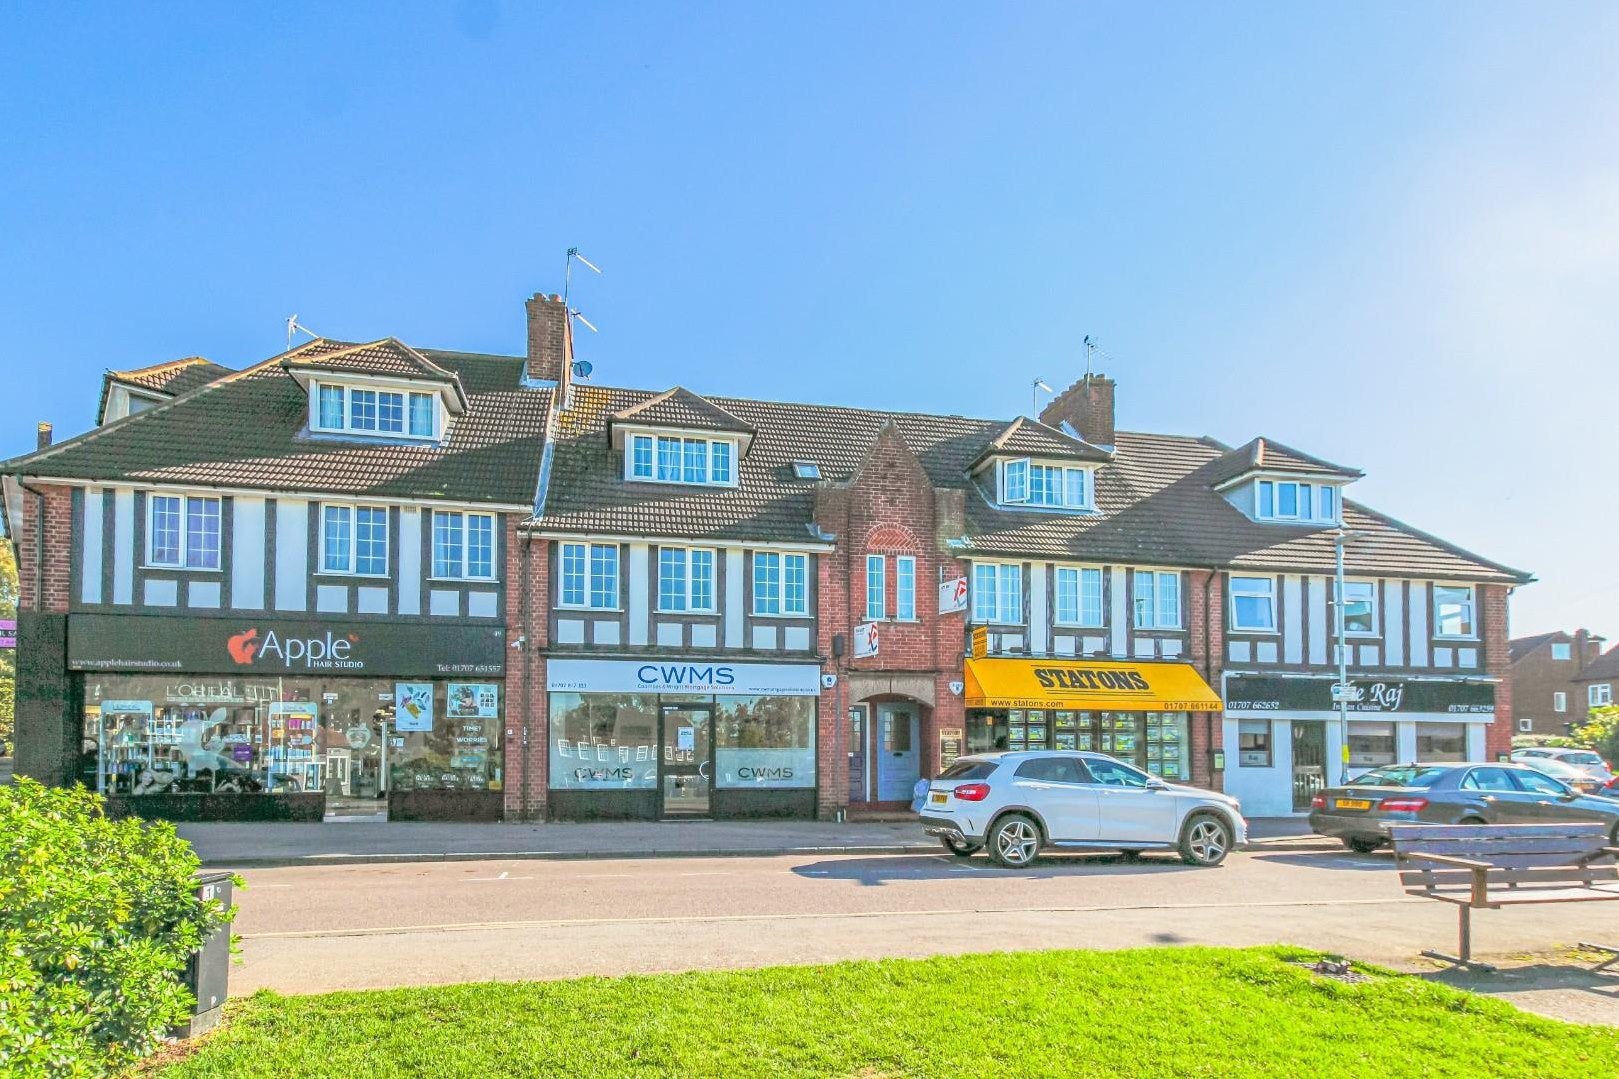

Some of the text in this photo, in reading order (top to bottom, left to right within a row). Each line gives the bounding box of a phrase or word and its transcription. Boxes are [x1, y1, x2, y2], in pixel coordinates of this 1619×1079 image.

[258, 630, 351, 667] Apple
[334, 661, 363, 669] STUDIO
[452, 664, 475, 672] 01707
[637, 665, 735, 685] CWMS
[1034, 668, 1150, 691] STATONS
[1370, 683, 1404, 711] Raj
[990, 700, 1064, 708] www.statons.com
[1164, 702, 1218, 710] 01707 661144
[1228, 701, 1251, 709] 01707
[1332, 702, 1381, 711] Inan Cuisine
[574, 768, 633, 779] CWMS
[738, 768, 794, 778] CWMS
